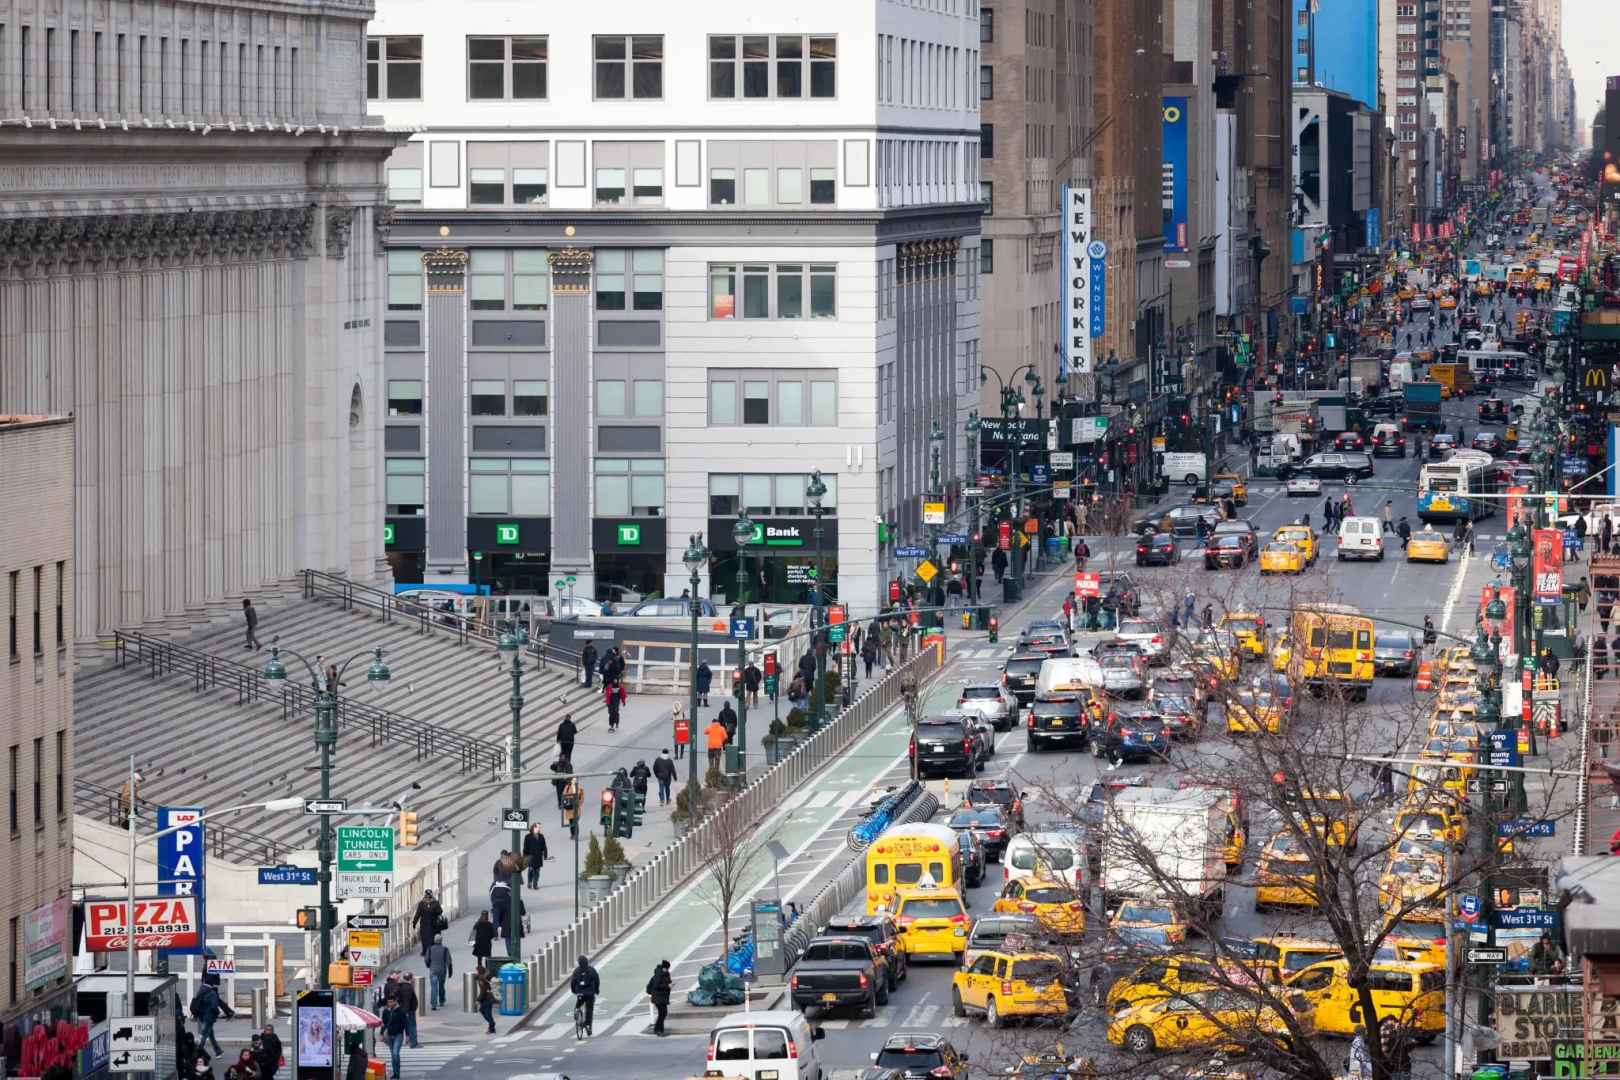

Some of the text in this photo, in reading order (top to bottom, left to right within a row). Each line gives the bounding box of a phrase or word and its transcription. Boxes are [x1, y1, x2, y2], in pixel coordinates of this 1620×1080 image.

[1072, 193, 1086, 244] NEW
[1093, 264, 1101, 332] WYNDHAM
[1072, 257, 1085, 369] YORKER
[981, 420, 1000, 428] New
[384, 526, 392, 540] D
[499, 528, 517, 540] TD
[620, 528, 638, 540] TD
[752, 527, 799, 540] D Bank
[1076, 580, 1098, 588] PARKING
[1536, 583, 1559, 591] TEAM
[342, 829, 389, 838] LINCOLN
[1503, 825, 1523, 833] West
[1541, 825, 1550, 833] St
[344, 840, 387, 849] TUNNEL
[894, 843, 922, 852] SCHOOL BUS
[174, 831, 196, 895] PAR
[286, 872, 300, 880] 31st
[90, 901, 188, 935] PIZZA
[1501, 914, 1553, 924] West 31st St
[208, 960, 234, 969] ATM
[1501, 993, 1590, 1015] BLARNE
[1515, 1017, 1584, 1039] STONE
[1502, 1041, 1551, 1057] RESTA
